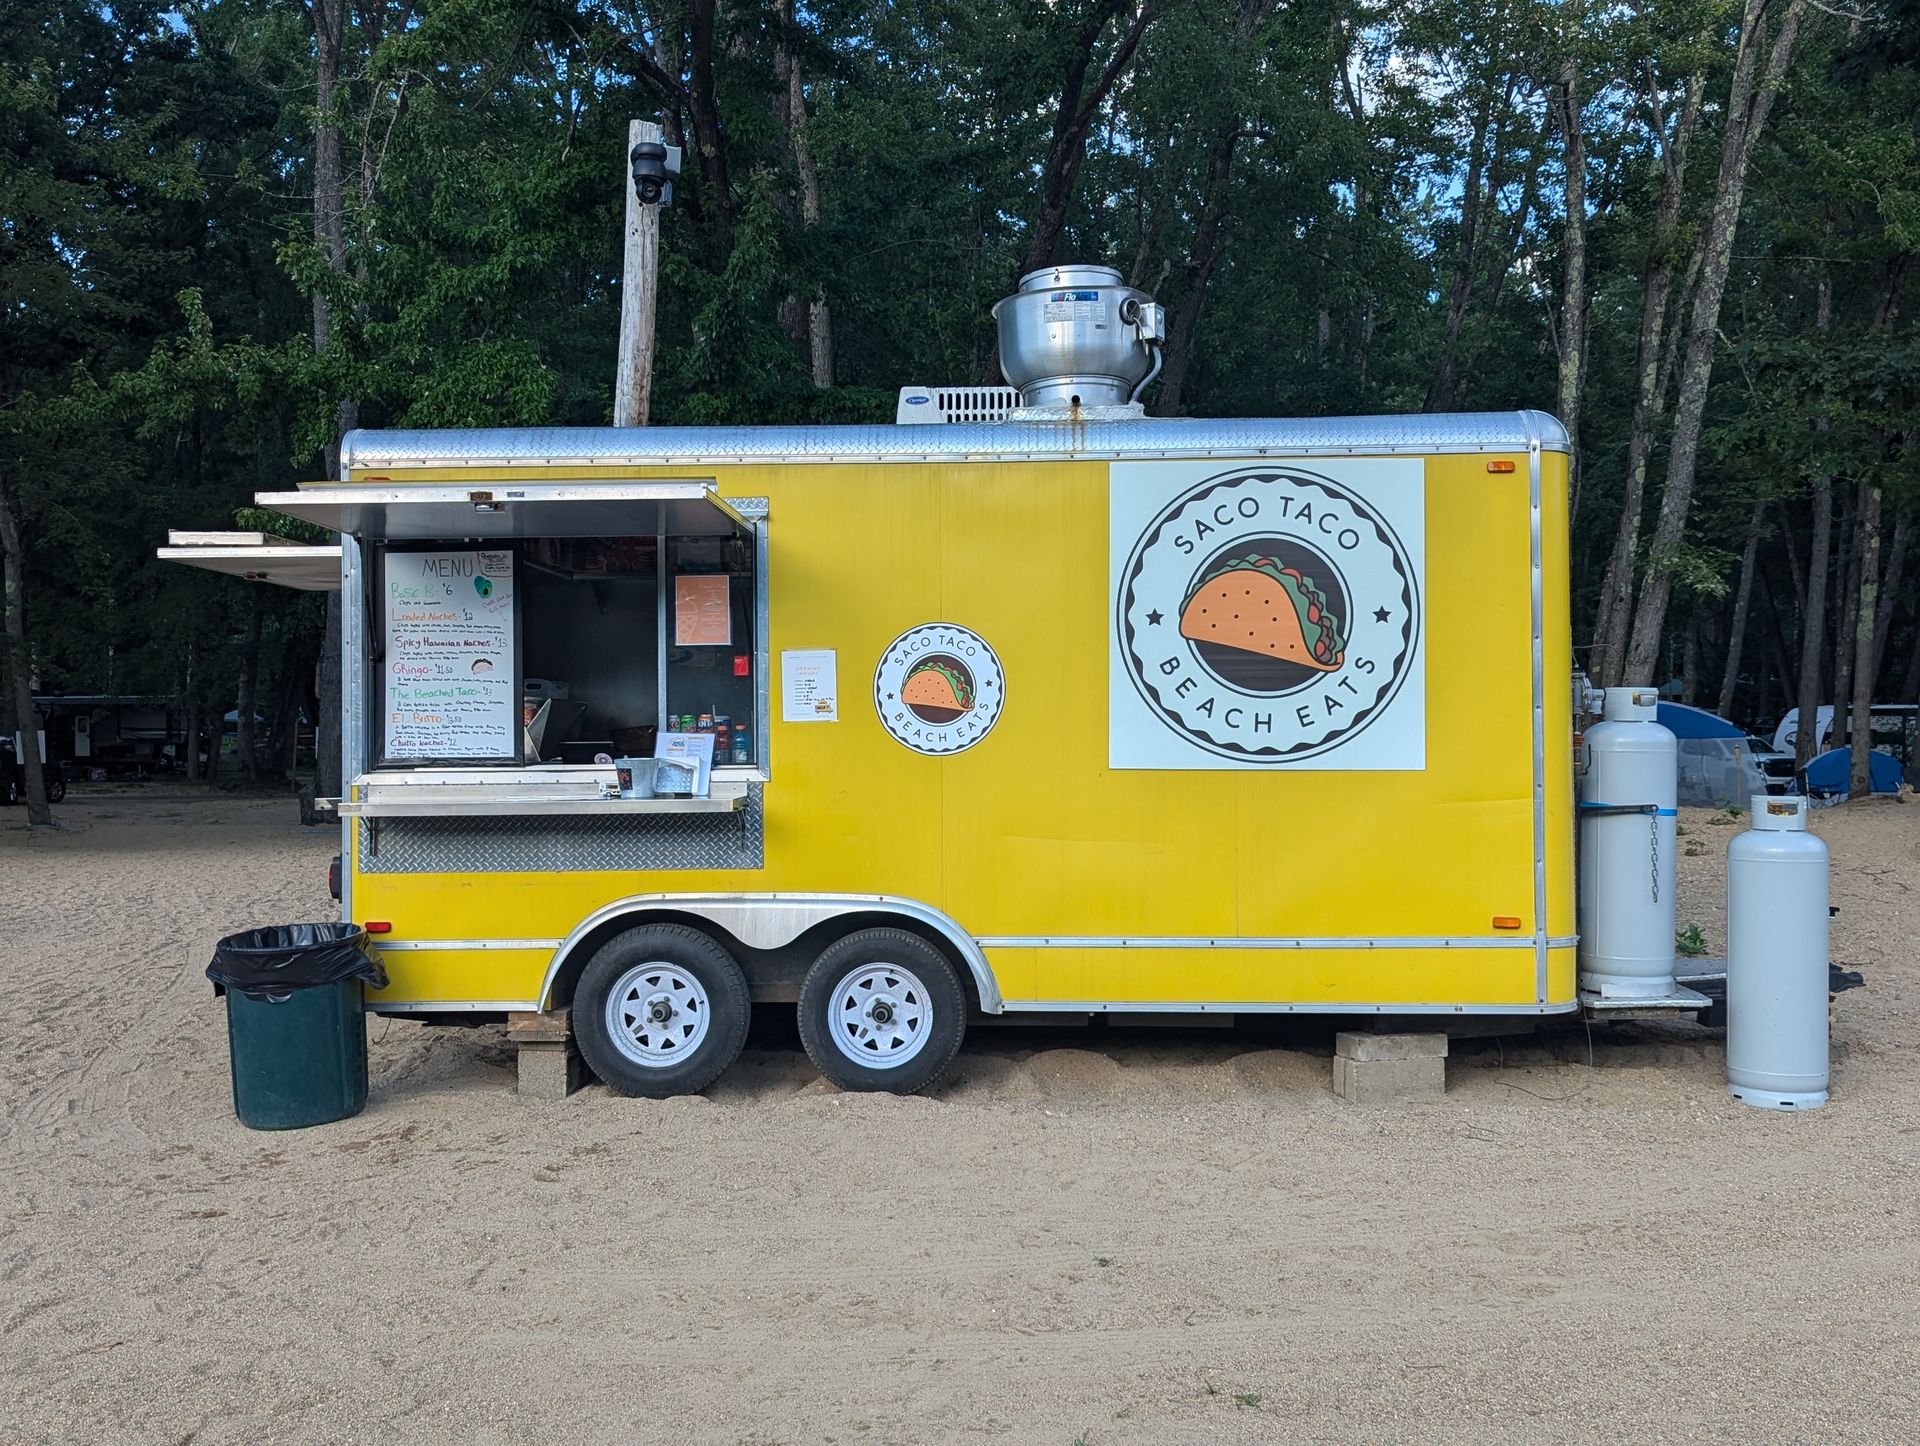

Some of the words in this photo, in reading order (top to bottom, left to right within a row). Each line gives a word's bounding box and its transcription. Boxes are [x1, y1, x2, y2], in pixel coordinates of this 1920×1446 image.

[1174, 497, 1260, 555] SACO
[1279, 496, 1360, 550] TACO
[421, 558, 474, 578] MENU
[391, 608, 426, 621] Loaded
[395, 636, 421, 650] Spicy
[423, 637, 461, 647] Hawaiian
[894, 636, 931, 666] SACO
[938, 634, 976, 656] TACO
[390, 687, 410, 700] The
[415, 688, 453, 698] Beached
[1160, 656, 1272, 733] BEACH
[1296, 656, 1376, 728] EATS
[894, 712, 947, 743] BEACH
[956, 702, 989, 739] EATS
